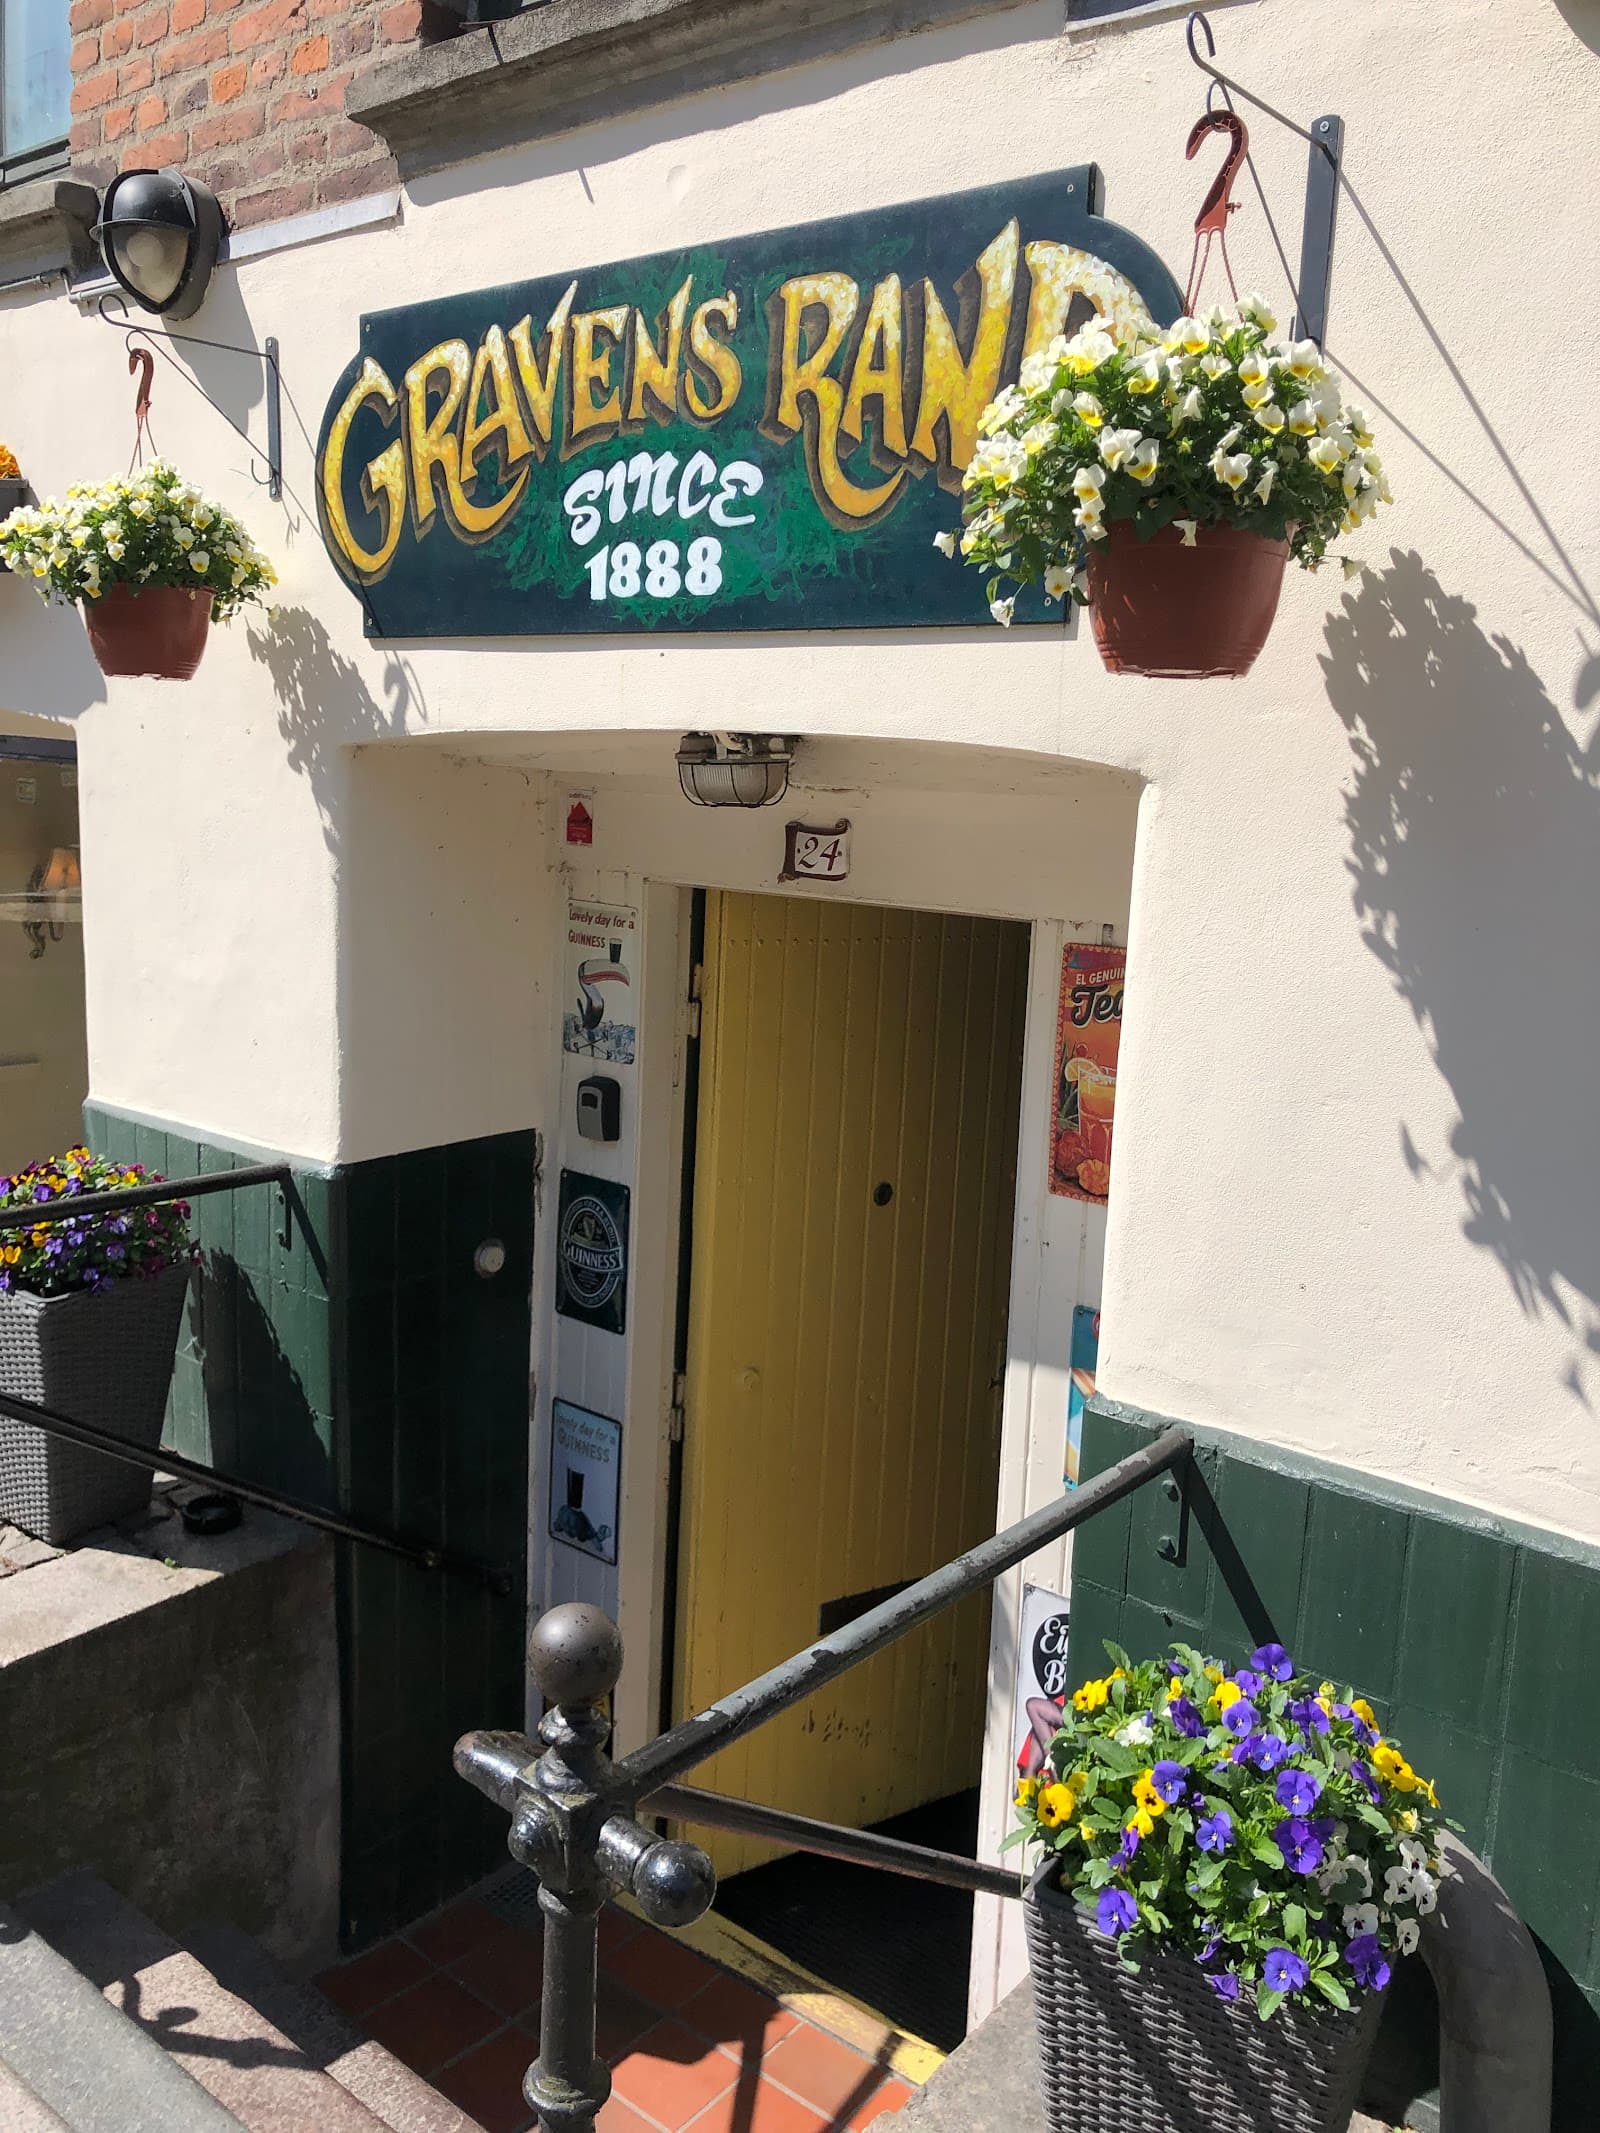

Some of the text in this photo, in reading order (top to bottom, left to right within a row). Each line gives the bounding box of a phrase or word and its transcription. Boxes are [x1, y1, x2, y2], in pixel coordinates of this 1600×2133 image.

[319, 273, 743, 578] GRAVENS
[563, 450, 764, 547] SINCE
[583, 535, 723, 600] 1888
[798, 836, 841, 871] 24
[568, 928, 606, 949] GUINNESS
[594, 913, 611, 929] day
[612, 915, 626, 929] for
[628, 920, 635, 929] a
[1075, 973, 1087, 985] EL
[562, 1239, 617, 1269] GUINNESS
[559, 1427, 610, 1463] GUINNESS
